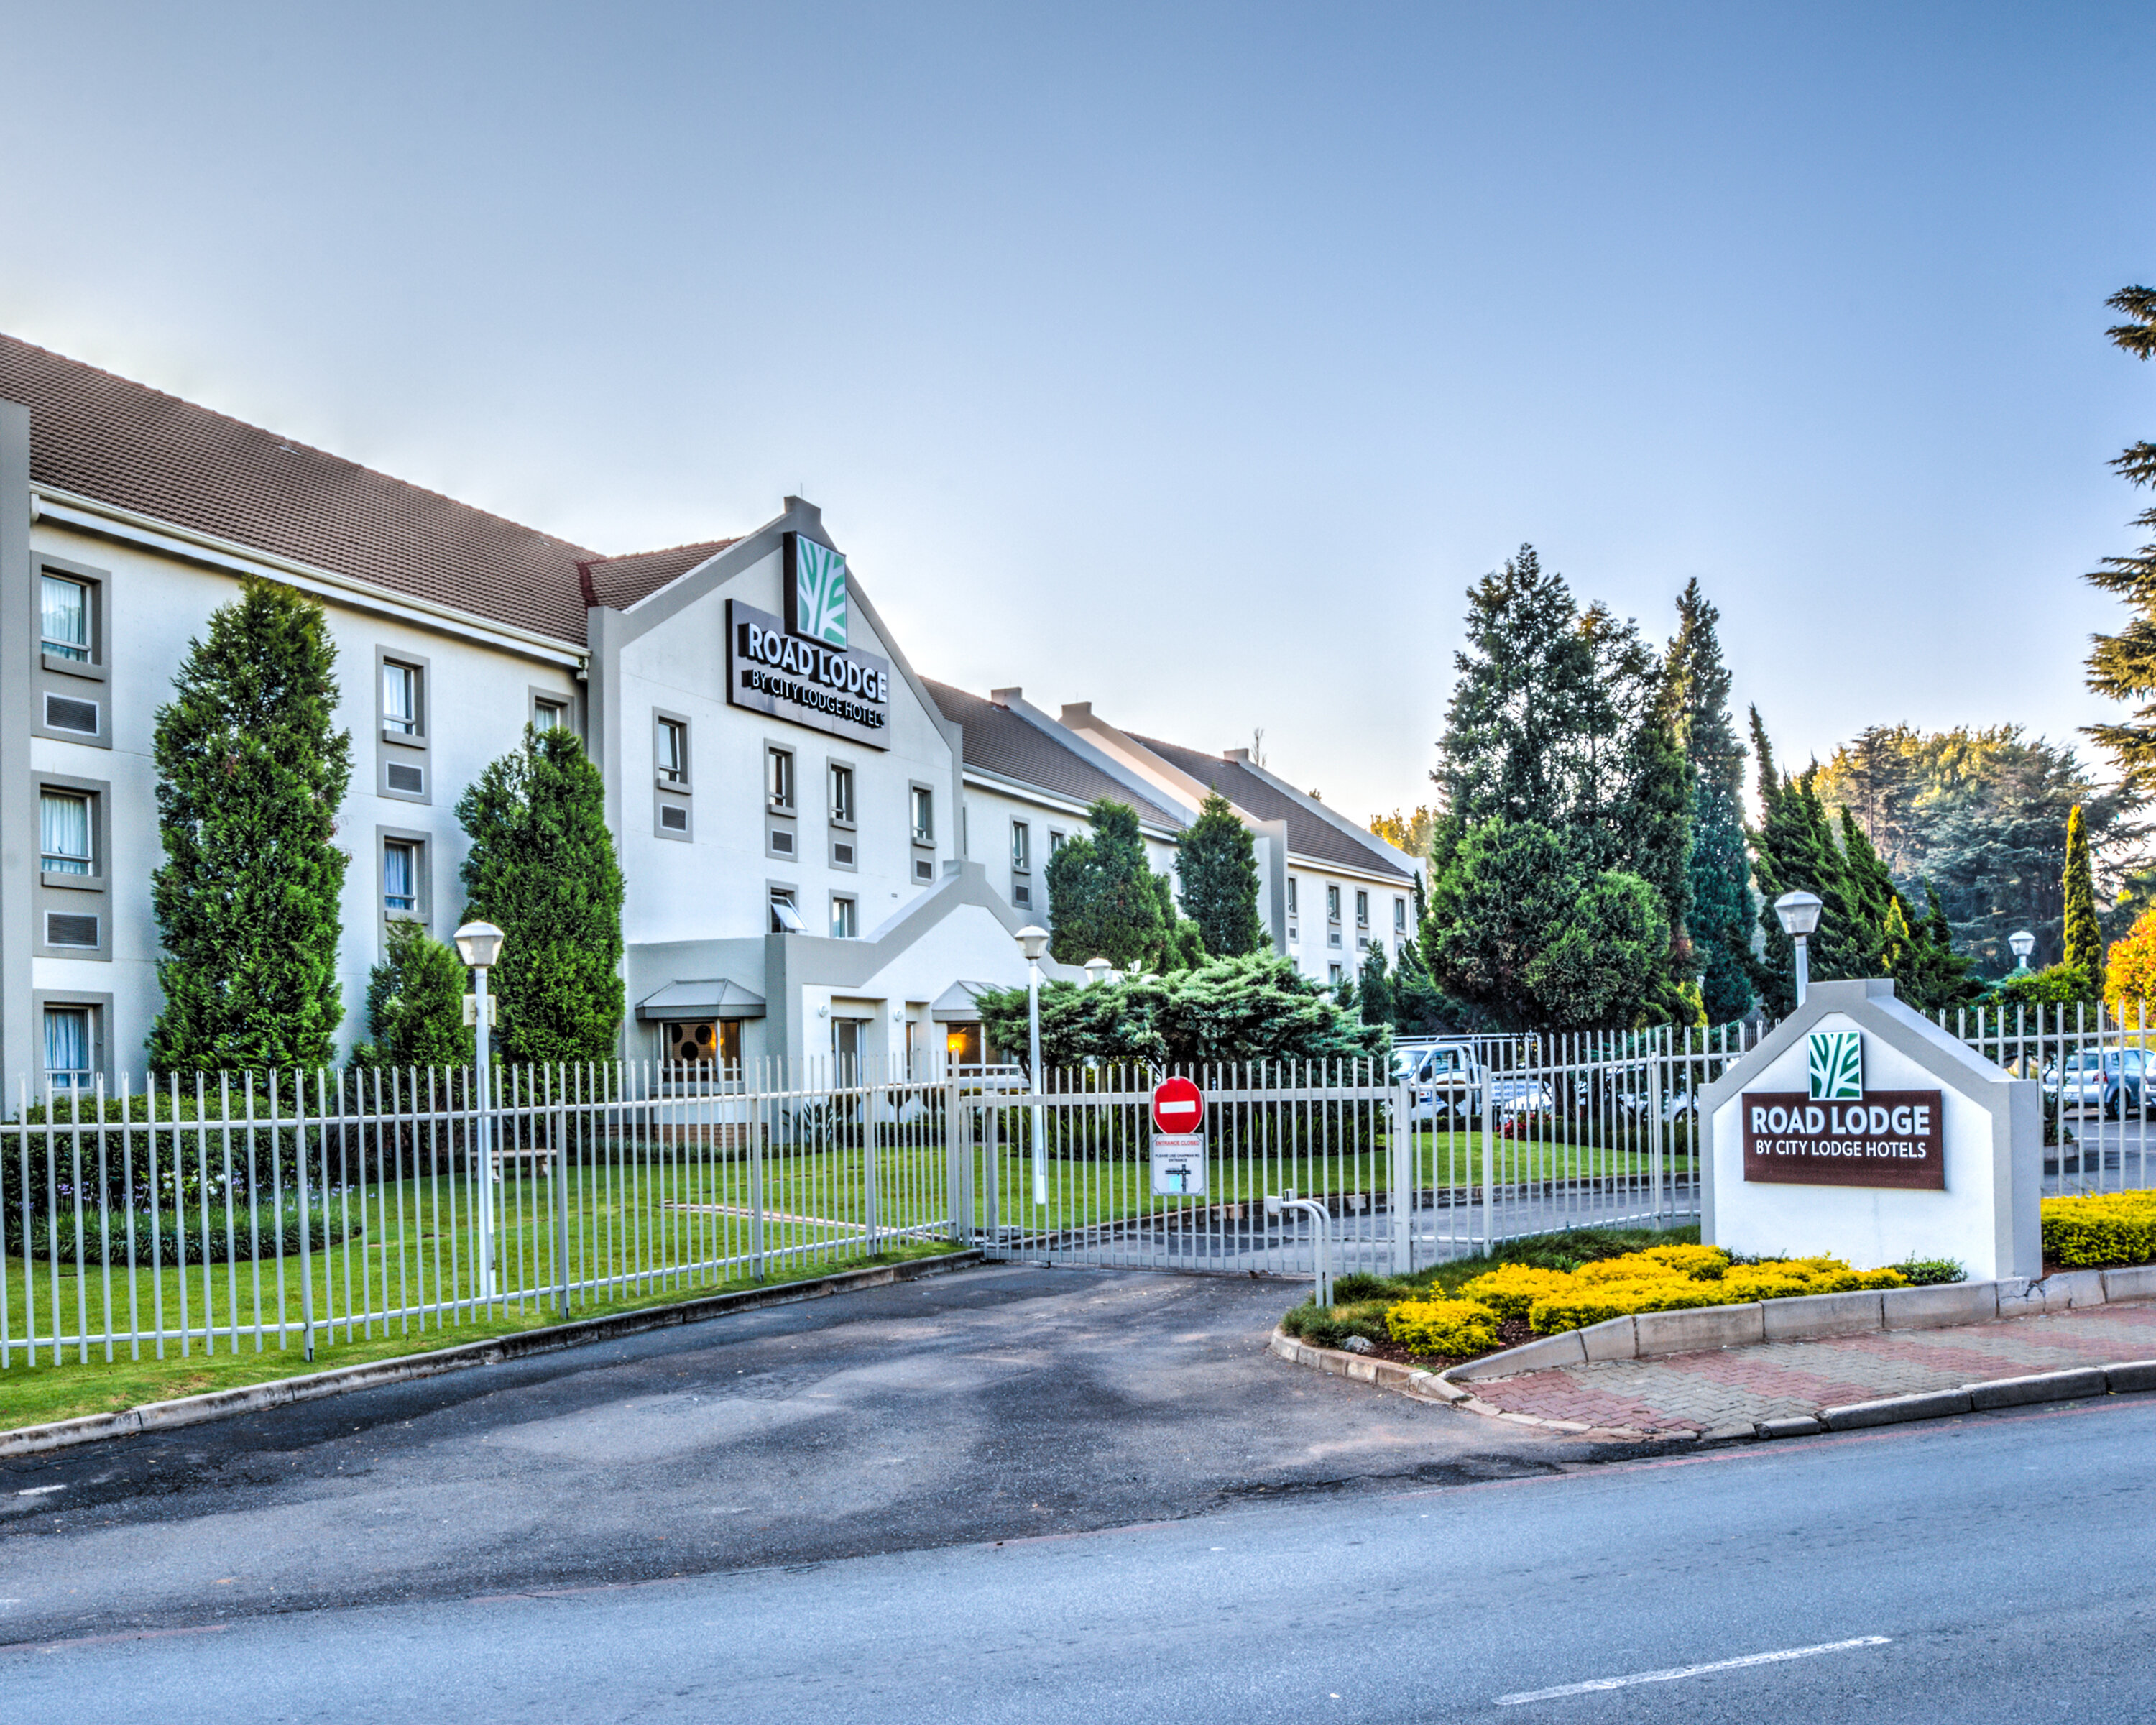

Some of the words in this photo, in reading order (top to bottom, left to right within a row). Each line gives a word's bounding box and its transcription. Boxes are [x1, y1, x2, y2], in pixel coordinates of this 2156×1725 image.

[749, 622, 814, 675] ROAD
[819, 649, 888, 703] LODGE
[752, 669, 766, 689] BY
[770, 676, 798, 699] CITY
[802, 686, 842, 714] LODGE
[845, 701, 885, 728] HOTELS
[1751, 1106, 1825, 1134] ROAD
[1831, 1105, 1930, 1136] LODGE
[1756, 1139, 1772, 1154] BY
[1776, 1140, 1807, 1155] CITY
[1812, 1141, 1862, 1157] LODGE
[1866, 1141, 1927, 1159] HOTELS
